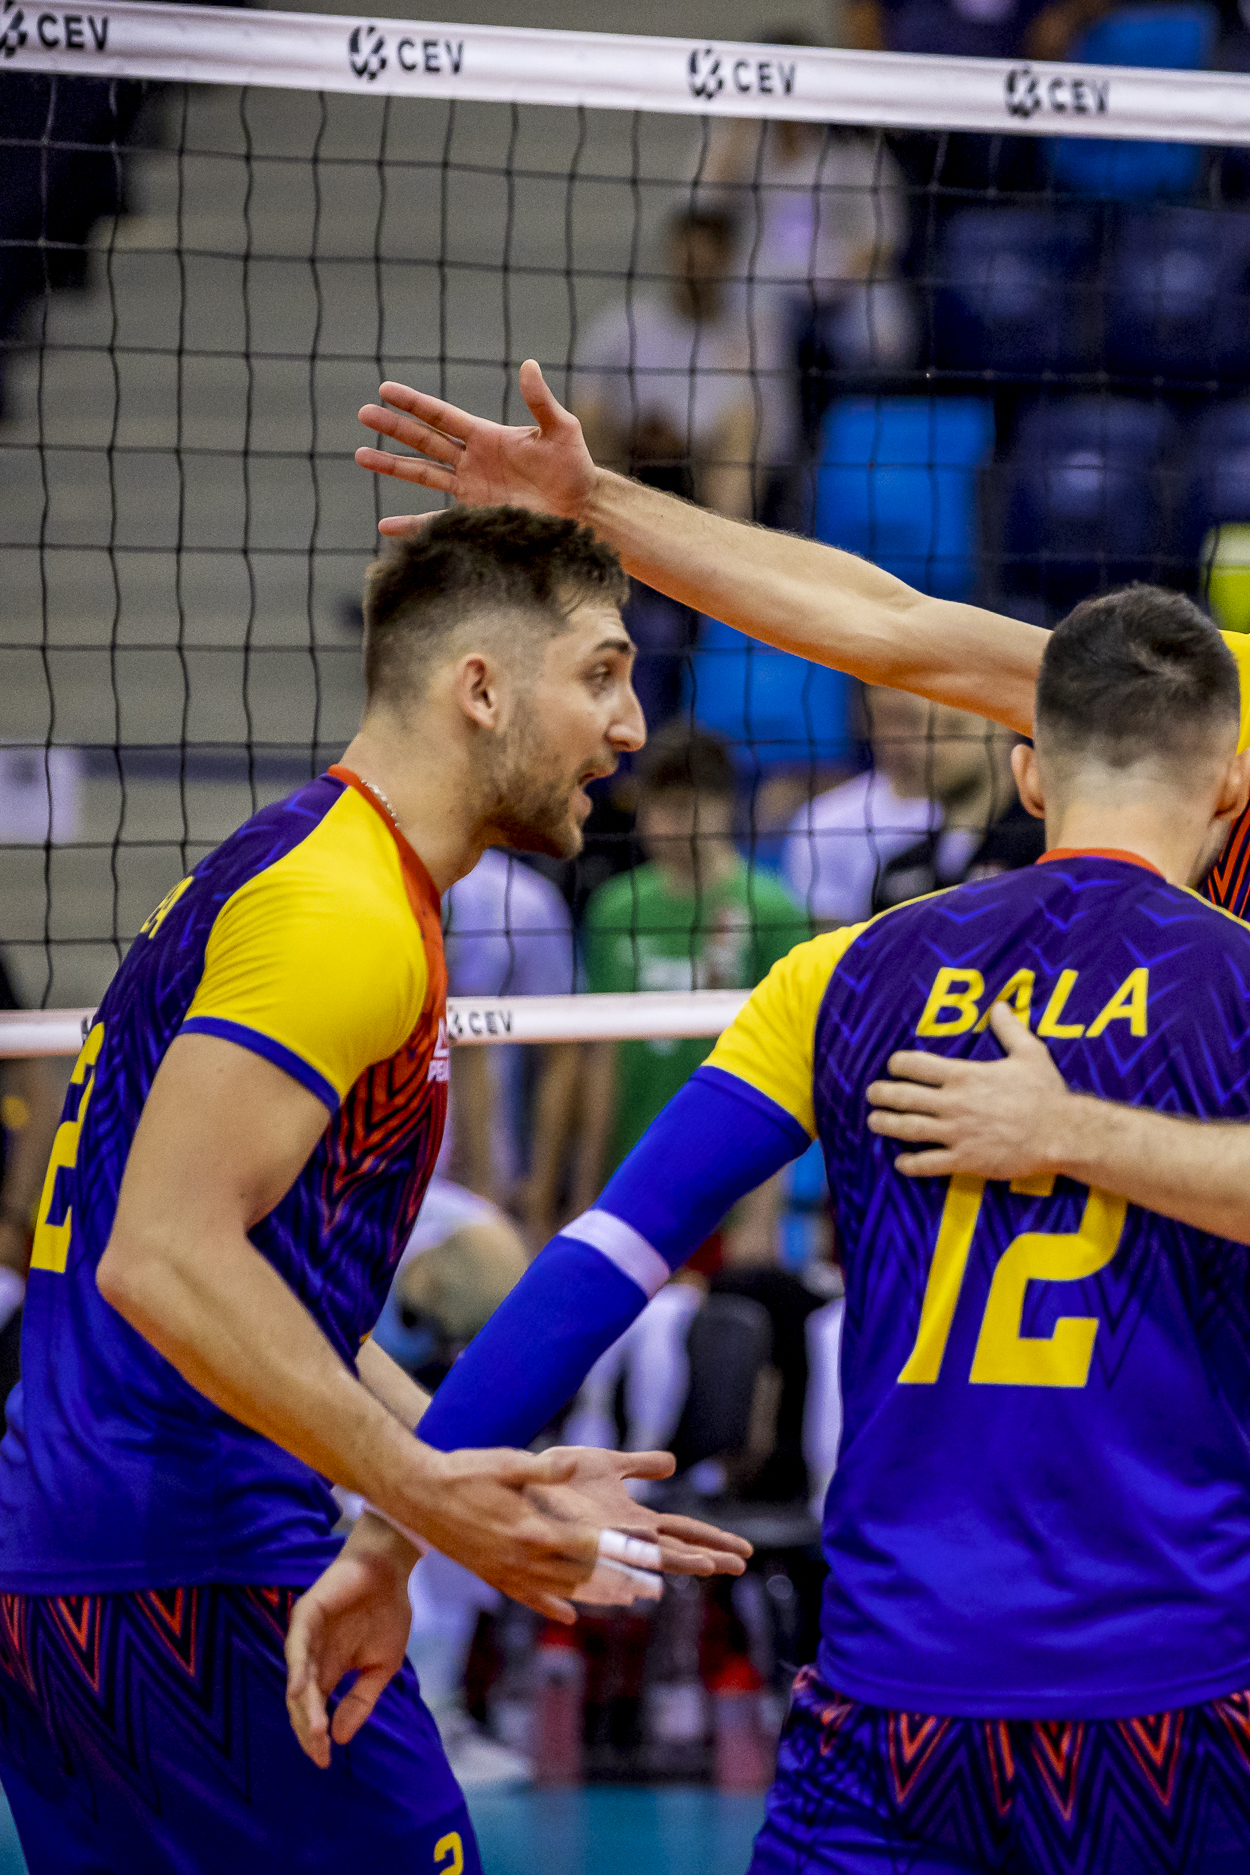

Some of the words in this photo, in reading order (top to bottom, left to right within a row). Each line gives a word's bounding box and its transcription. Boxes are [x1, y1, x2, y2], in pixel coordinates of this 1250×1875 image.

[37, 12, 109, 50] CEV
[397, 37, 464, 74] CEV
[733, 60, 796, 96] CEV
[1048, 77, 1110, 115] CEV
[915, 967, 1149, 1038] BALA
[468, 1010, 512, 1034] CEV
[897, 1167, 1129, 1388] 12
